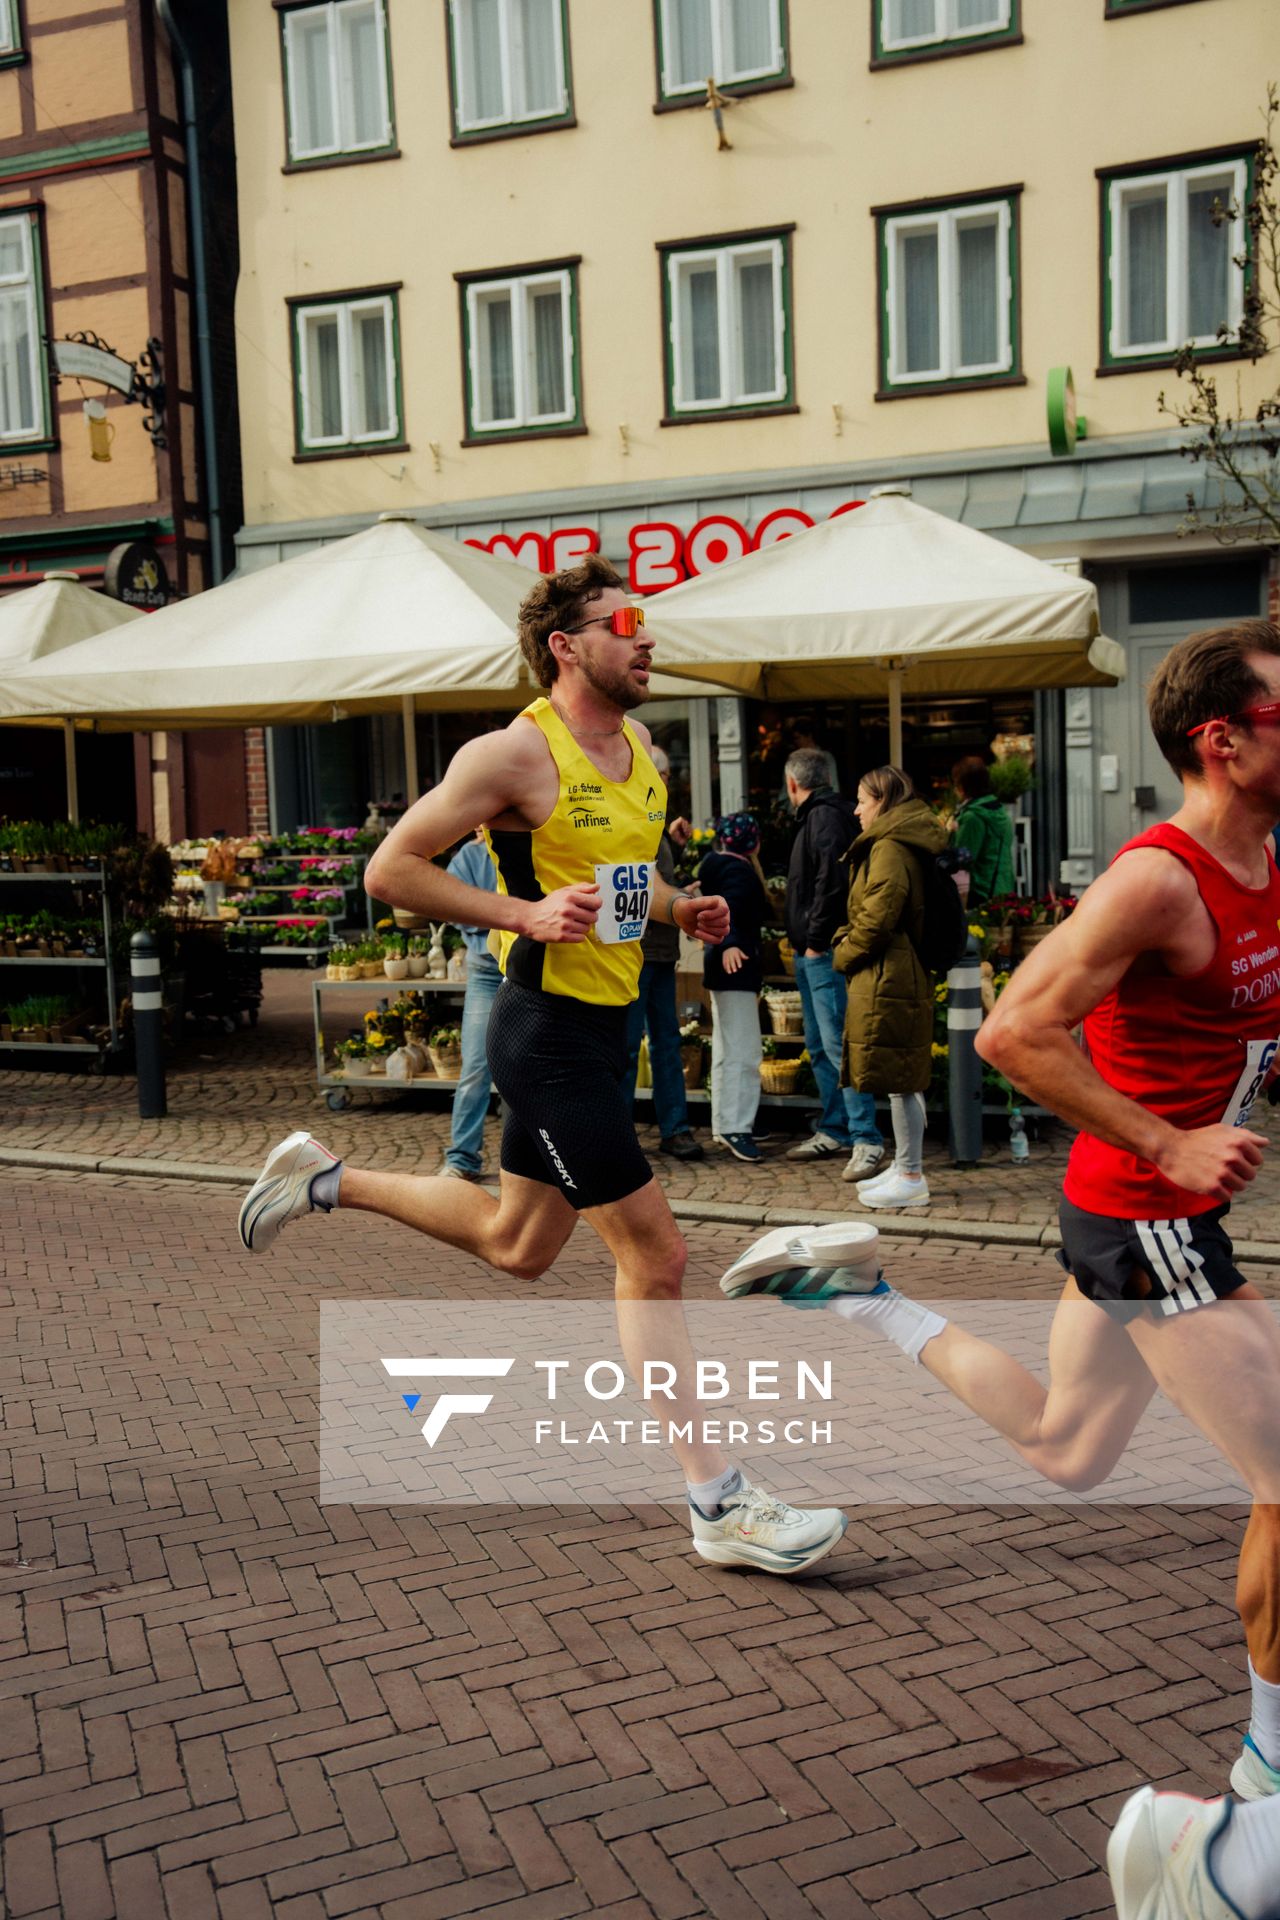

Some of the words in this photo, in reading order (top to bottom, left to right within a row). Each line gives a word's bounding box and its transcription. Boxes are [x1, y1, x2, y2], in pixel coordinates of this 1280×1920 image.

[573, 814, 611, 828] infinex
[614, 890, 649, 923] 940
[1231, 957, 1249, 976] SG
[1248, 945, 1280, 969] Wenden
[538, 1127, 578, 1190] SAYSKY
